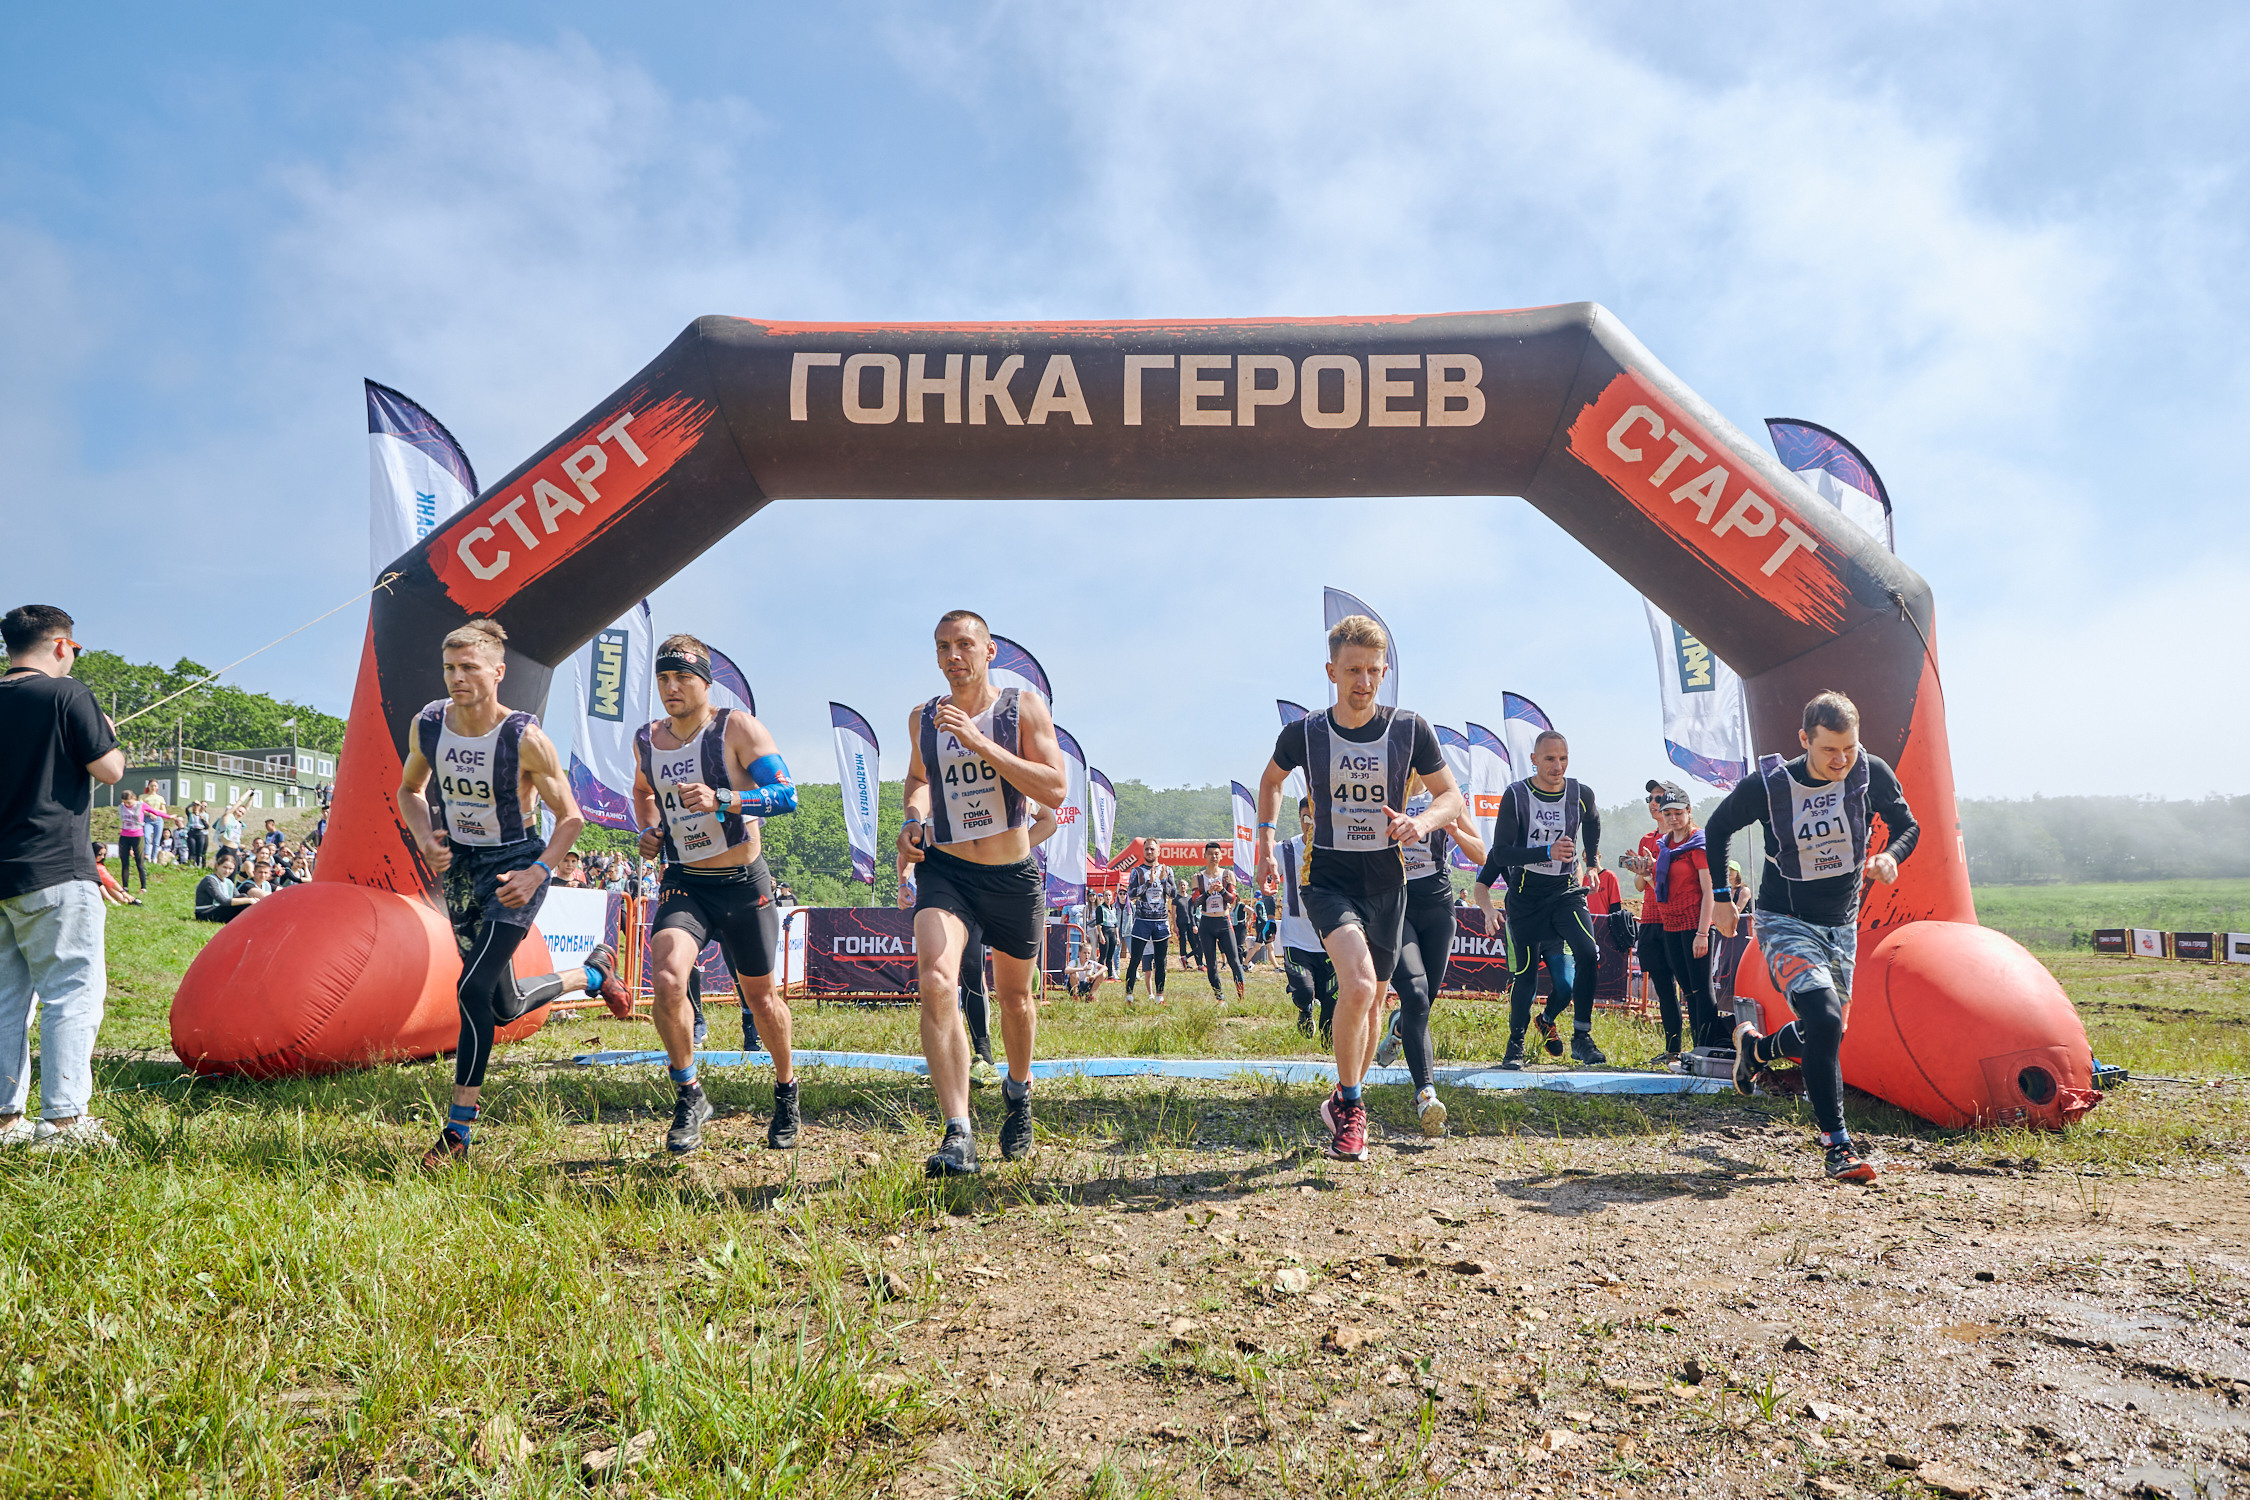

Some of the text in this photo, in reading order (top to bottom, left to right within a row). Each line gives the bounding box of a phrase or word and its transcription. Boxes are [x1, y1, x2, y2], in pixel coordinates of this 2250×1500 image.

[789, 352, 1487, 429] ГОНКА ГЕРОЕВ
[457, 411, 649, 580] СТАРТ
[1606, 405, 1820, 578] СТАРТ
[445, 748, 486, 767] AGE
[1340, 756, 1379, 771] AGE
[456, 765, 475, 773] 35-39
[661, 759, 695, 779] AGE
[945, 760, 997, 786] 406
[1351, 772, 1370, 780] 35-39
[443, 776, 490, 799] 403
[962, 787, 996, 797] ГАЗПРОМБАНК
[1334, 783, 1385, 803] 409
[1802, 794, 1837, 811] AGE
[964, 809, 991, 820] ГОНКА
[1405, 807, 1426, 817] GE
[1536, 810, 1560, 821] AGE
[1811, 809, 1829, 817] 35-39
[457, 819, 483, 827] ГОНКА
[964, 818, 993, 830] ГЕРОЕВ
[1798, 816, 1845, 841] 401
[458, 827, 486, 836] ГЕРОЕВ
[684, 831, 708, 842] ГОНКА
[1530, 828, 1564, 842] 417
[685, 840, 712, 852] ГЕРОЕВ
[1160, 847, 1198, 858] ОНКА
[1816, 855, 1840, 863] ГОНКА
[1815, 862, 1843, 871] ГЕРОЕВ
[833, 936, 905, 954] ГОНКА
[1450, 936, 1506, 956] ОНКА
